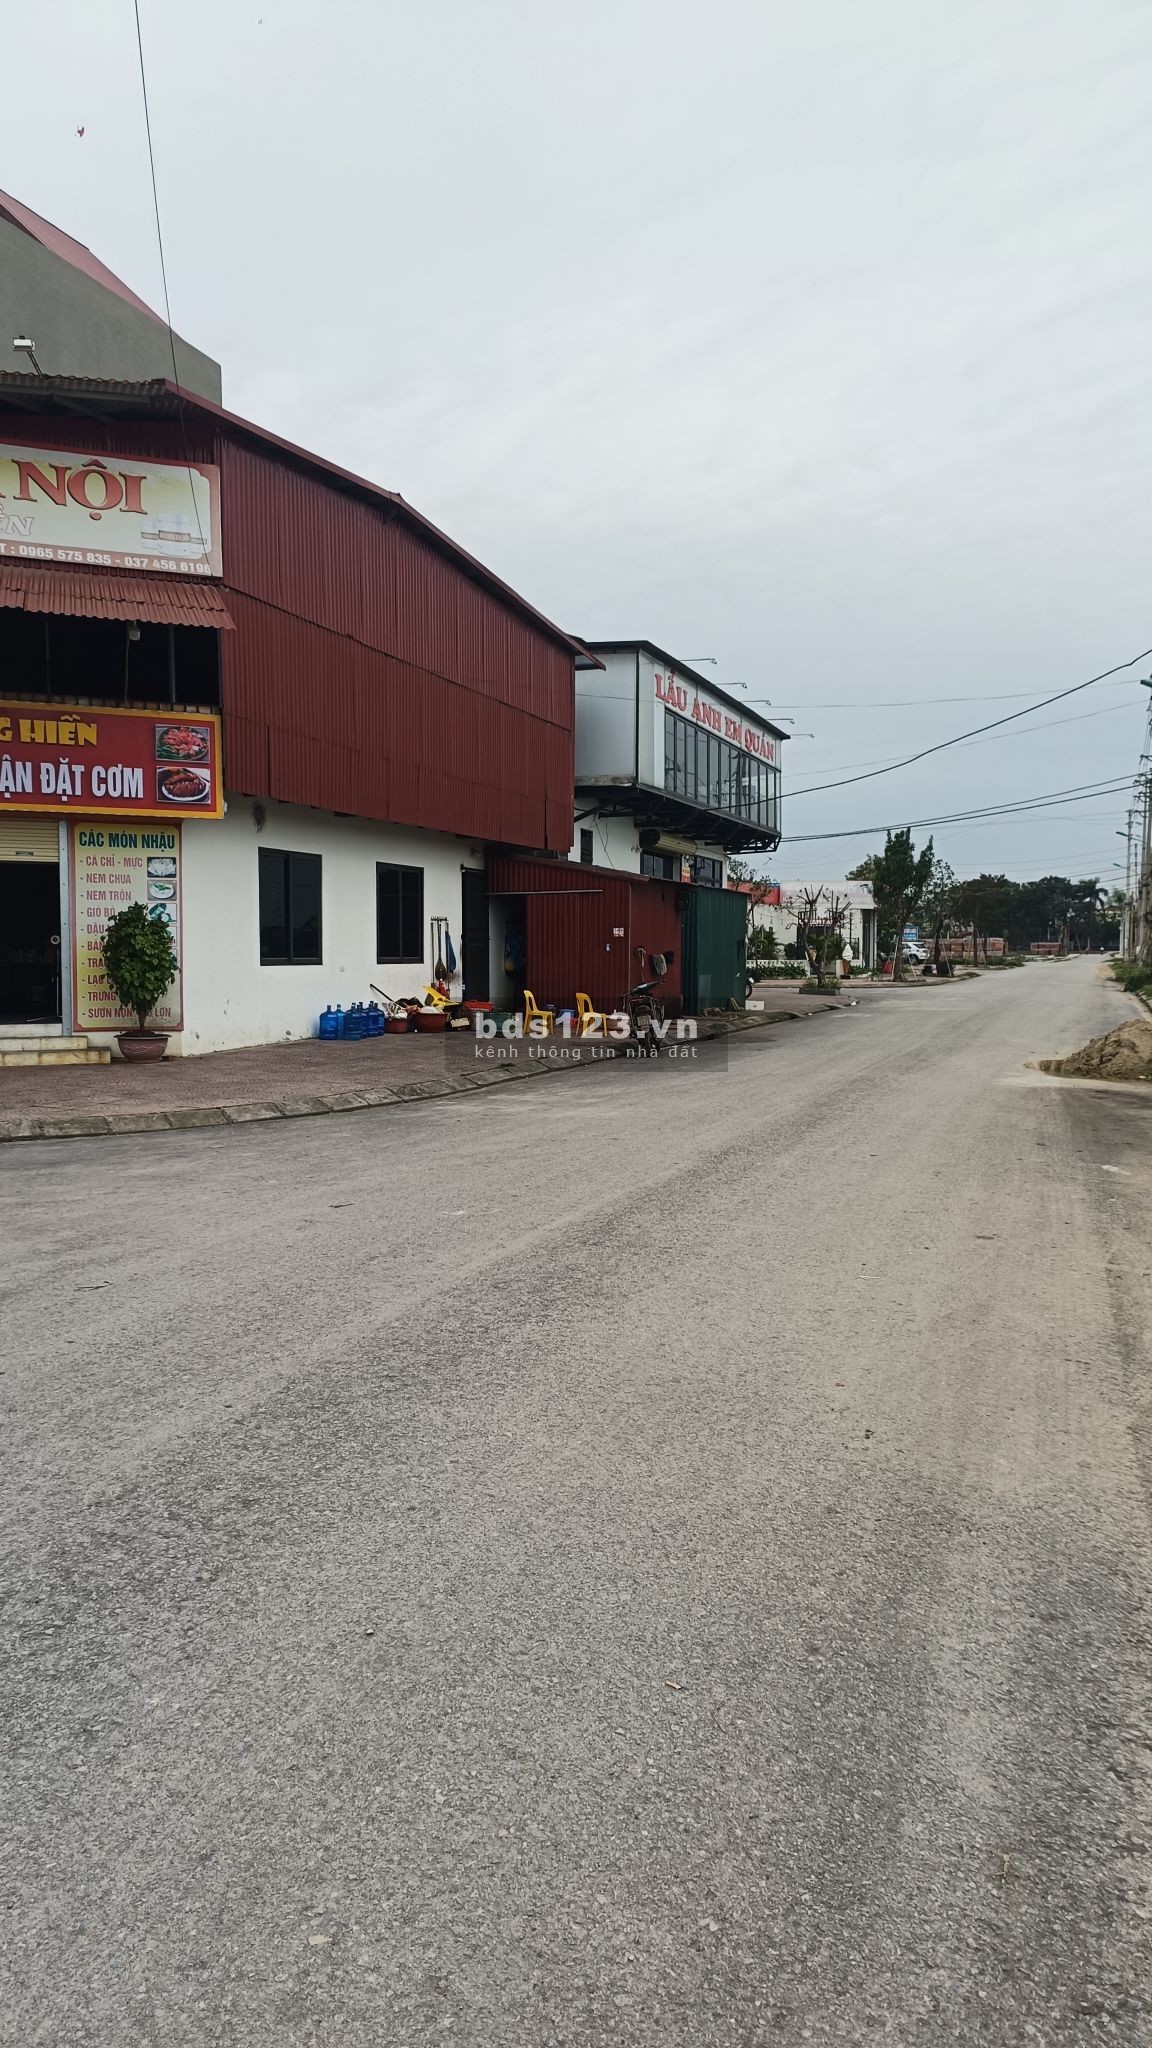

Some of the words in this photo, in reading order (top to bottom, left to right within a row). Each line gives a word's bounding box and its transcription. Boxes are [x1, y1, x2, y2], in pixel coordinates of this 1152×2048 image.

[11, 458, 148, 520] NỘI
[19, 545, 54, 559] 0965
[57, 549, 83, 561] 575
[86, 552, 111, 565] 835
[124, 556, 149, 568] 037
[152, 559, 177, 571] 456
[19, 713, 98, 746] HIỀN
[691, 698, 721, 733] ANH
[725, 716, 742, 744] EM
[745, 729, 774, 762] QUÁN
[40, 757, 85, 801] ĐẶT
[92, 763, 144, 799] CƠM
[79, 829, 105, 847] CÁC
[108, 830, 138, 849] MÓN
[141, 832, 175, 852] NHẬU
[86, 854, 98, 867] CÁ
[123, 856, 143, 870] MỰC
[86, 873, 106, 884] NEM
[109, 874, 132, 884] CHUA
[86, 891, 106, 901] NEM
